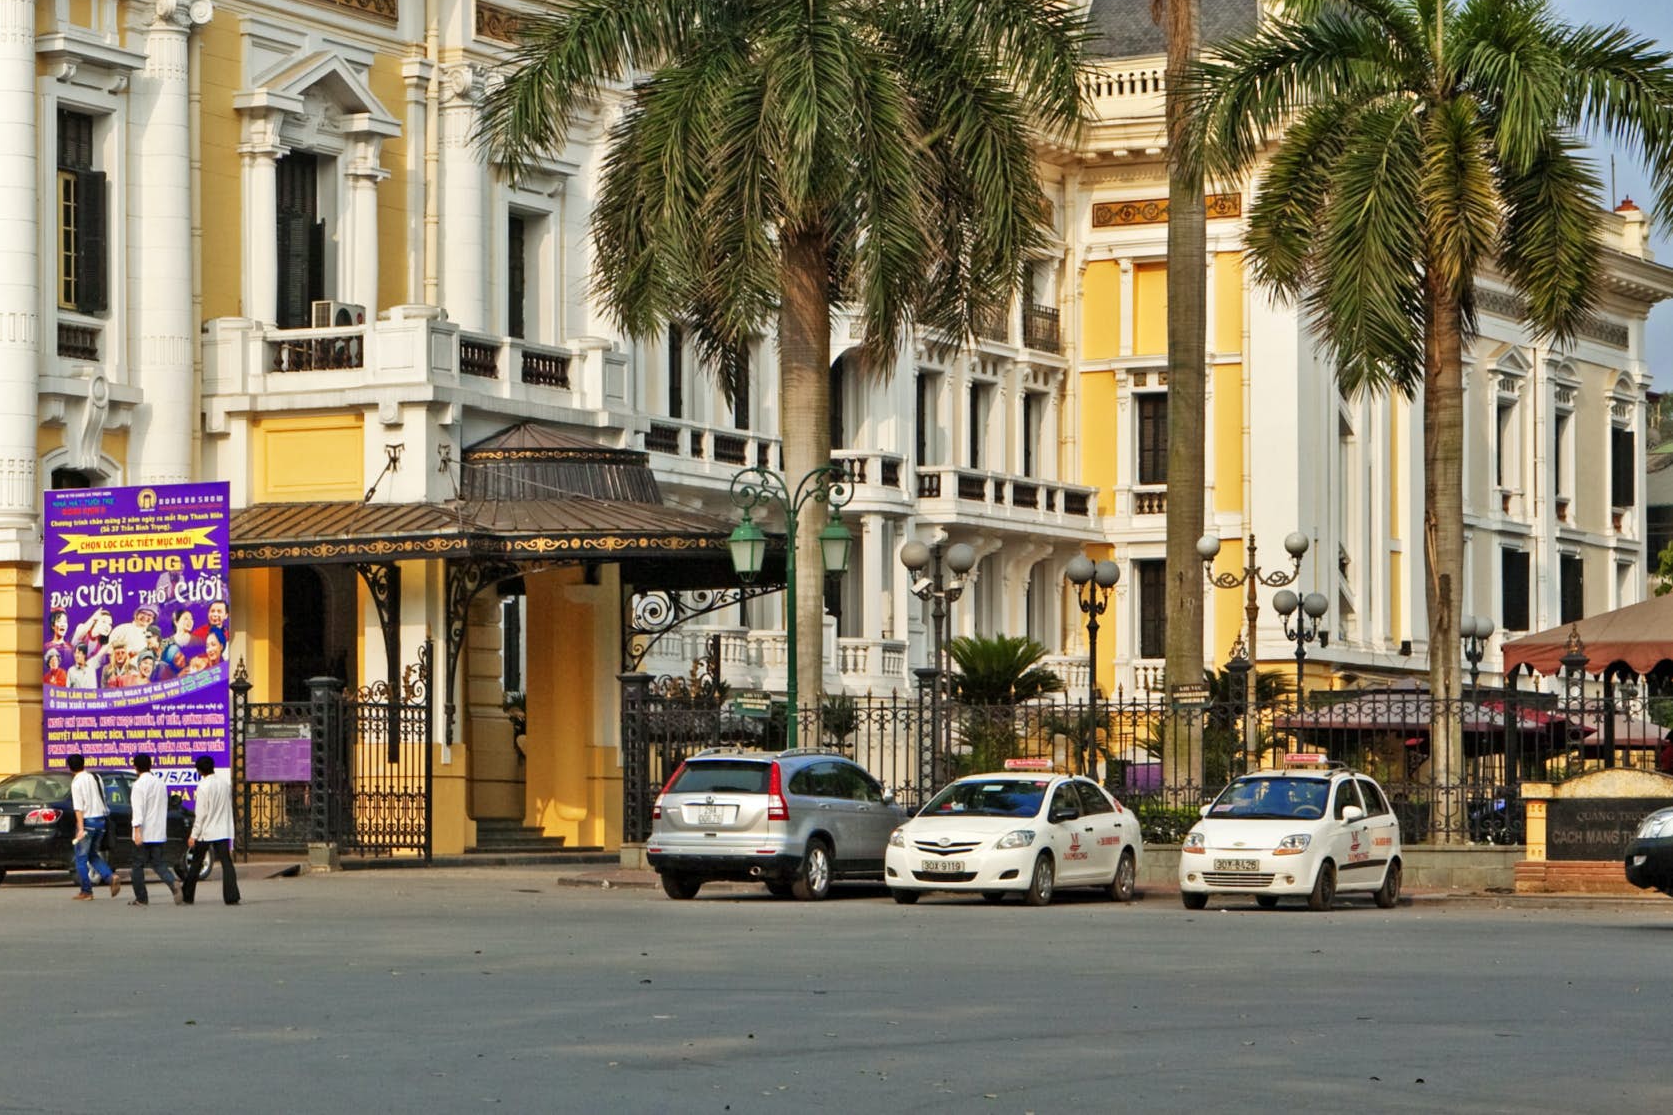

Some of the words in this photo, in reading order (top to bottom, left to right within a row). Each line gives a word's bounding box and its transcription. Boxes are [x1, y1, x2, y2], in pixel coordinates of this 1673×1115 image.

[81, 541, 101, 552] CHỌN
[104, 540, 116, 550] LỌC
[120, 539, 134, 548] CÁC
[137, 538, 153, 548] TIẾT
[157, 538, 173, 548] MỤC
[91, 553, 182, 574] PHÒNG
[189, 550, 222, 570] VÉ
